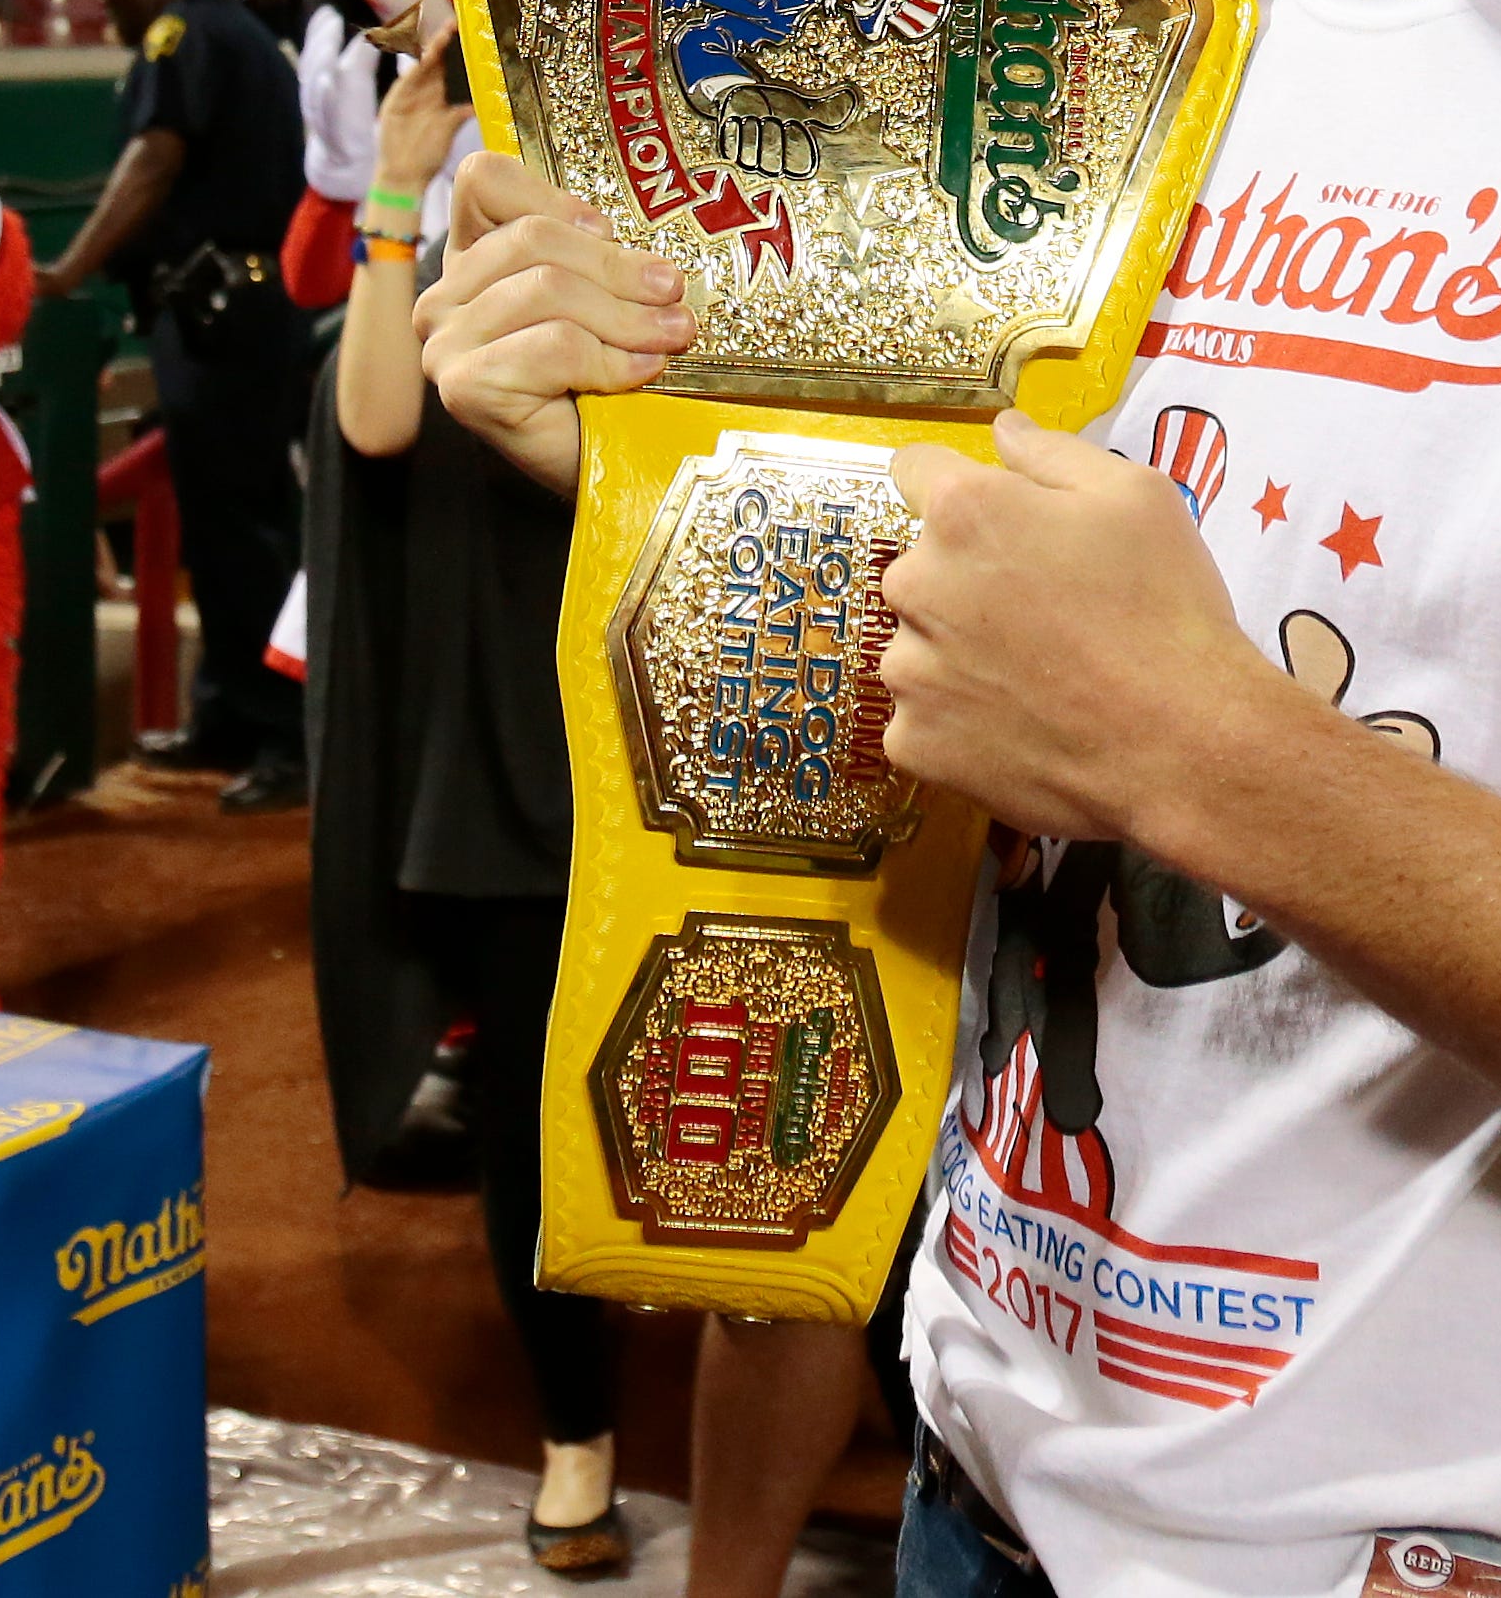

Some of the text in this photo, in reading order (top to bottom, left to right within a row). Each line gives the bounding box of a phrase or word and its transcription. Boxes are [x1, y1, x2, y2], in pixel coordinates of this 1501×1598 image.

[1317, 183, 1442, 217] SINCE 1916
[1160, 324, 1256, 364] FAMOUS
[703, 488, 770, 803] CONTEST
[753, 524, 811, 770] EATING
[794, 502, 856, 803] HOT DOG
[665, 996, 749, 1166] 100
[942, 1141, 974, 1212] DOG
[979, 1190, 1087, 1283] EATING
[1093, 1258, 1315, 1337] CONTEST
[983, 1246, 1082, 1356] 2017
[1405, 1552, 1454, 1576] REDS
